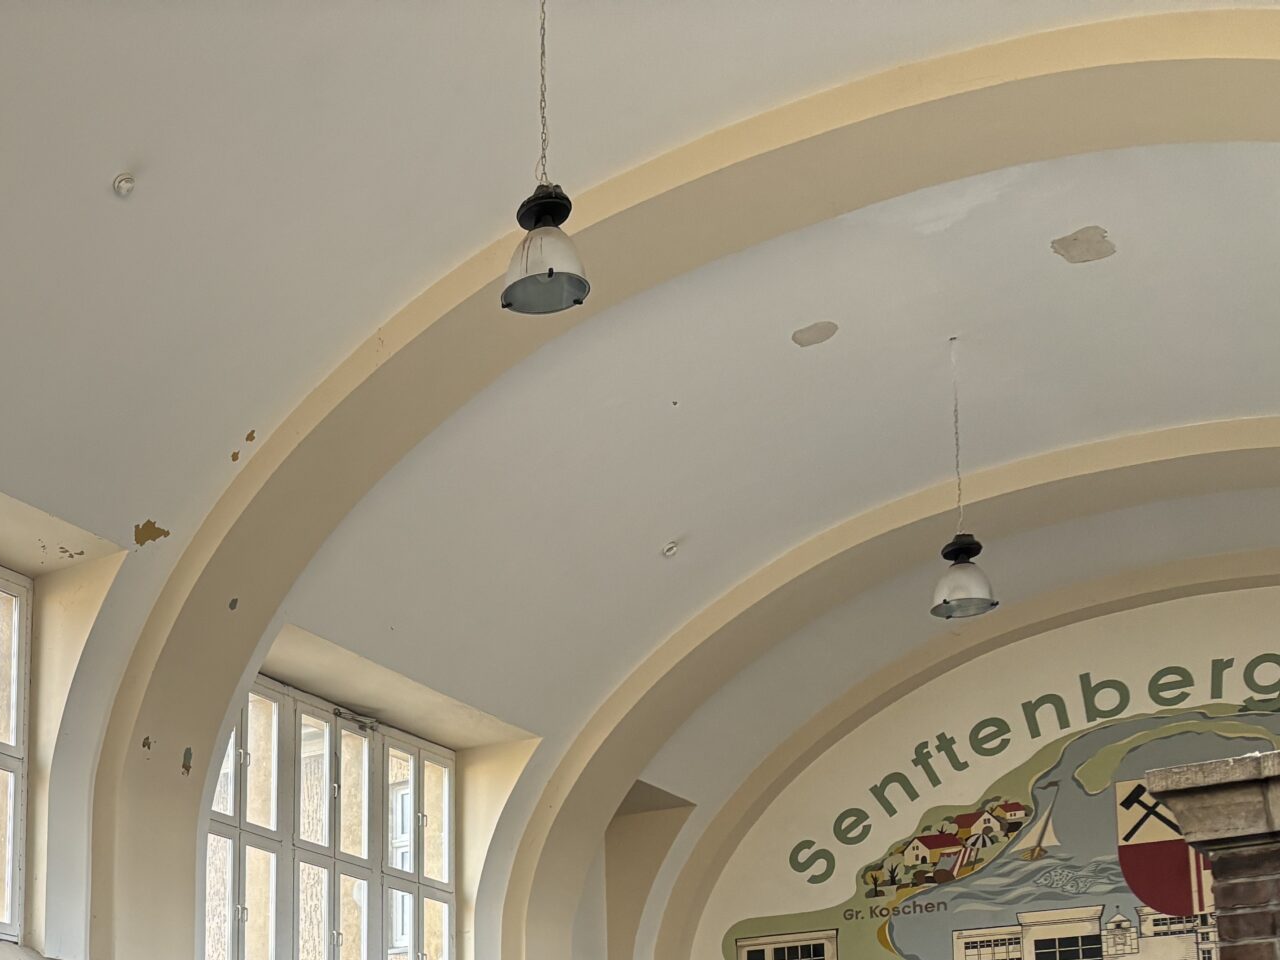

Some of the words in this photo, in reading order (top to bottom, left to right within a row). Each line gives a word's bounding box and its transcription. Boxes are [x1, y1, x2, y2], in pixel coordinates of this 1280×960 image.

[788, 652, 1280, 885] Senftenberg
[843, 908, 865, 920] Gr.
[869, 901, 948, 919] Koschen
